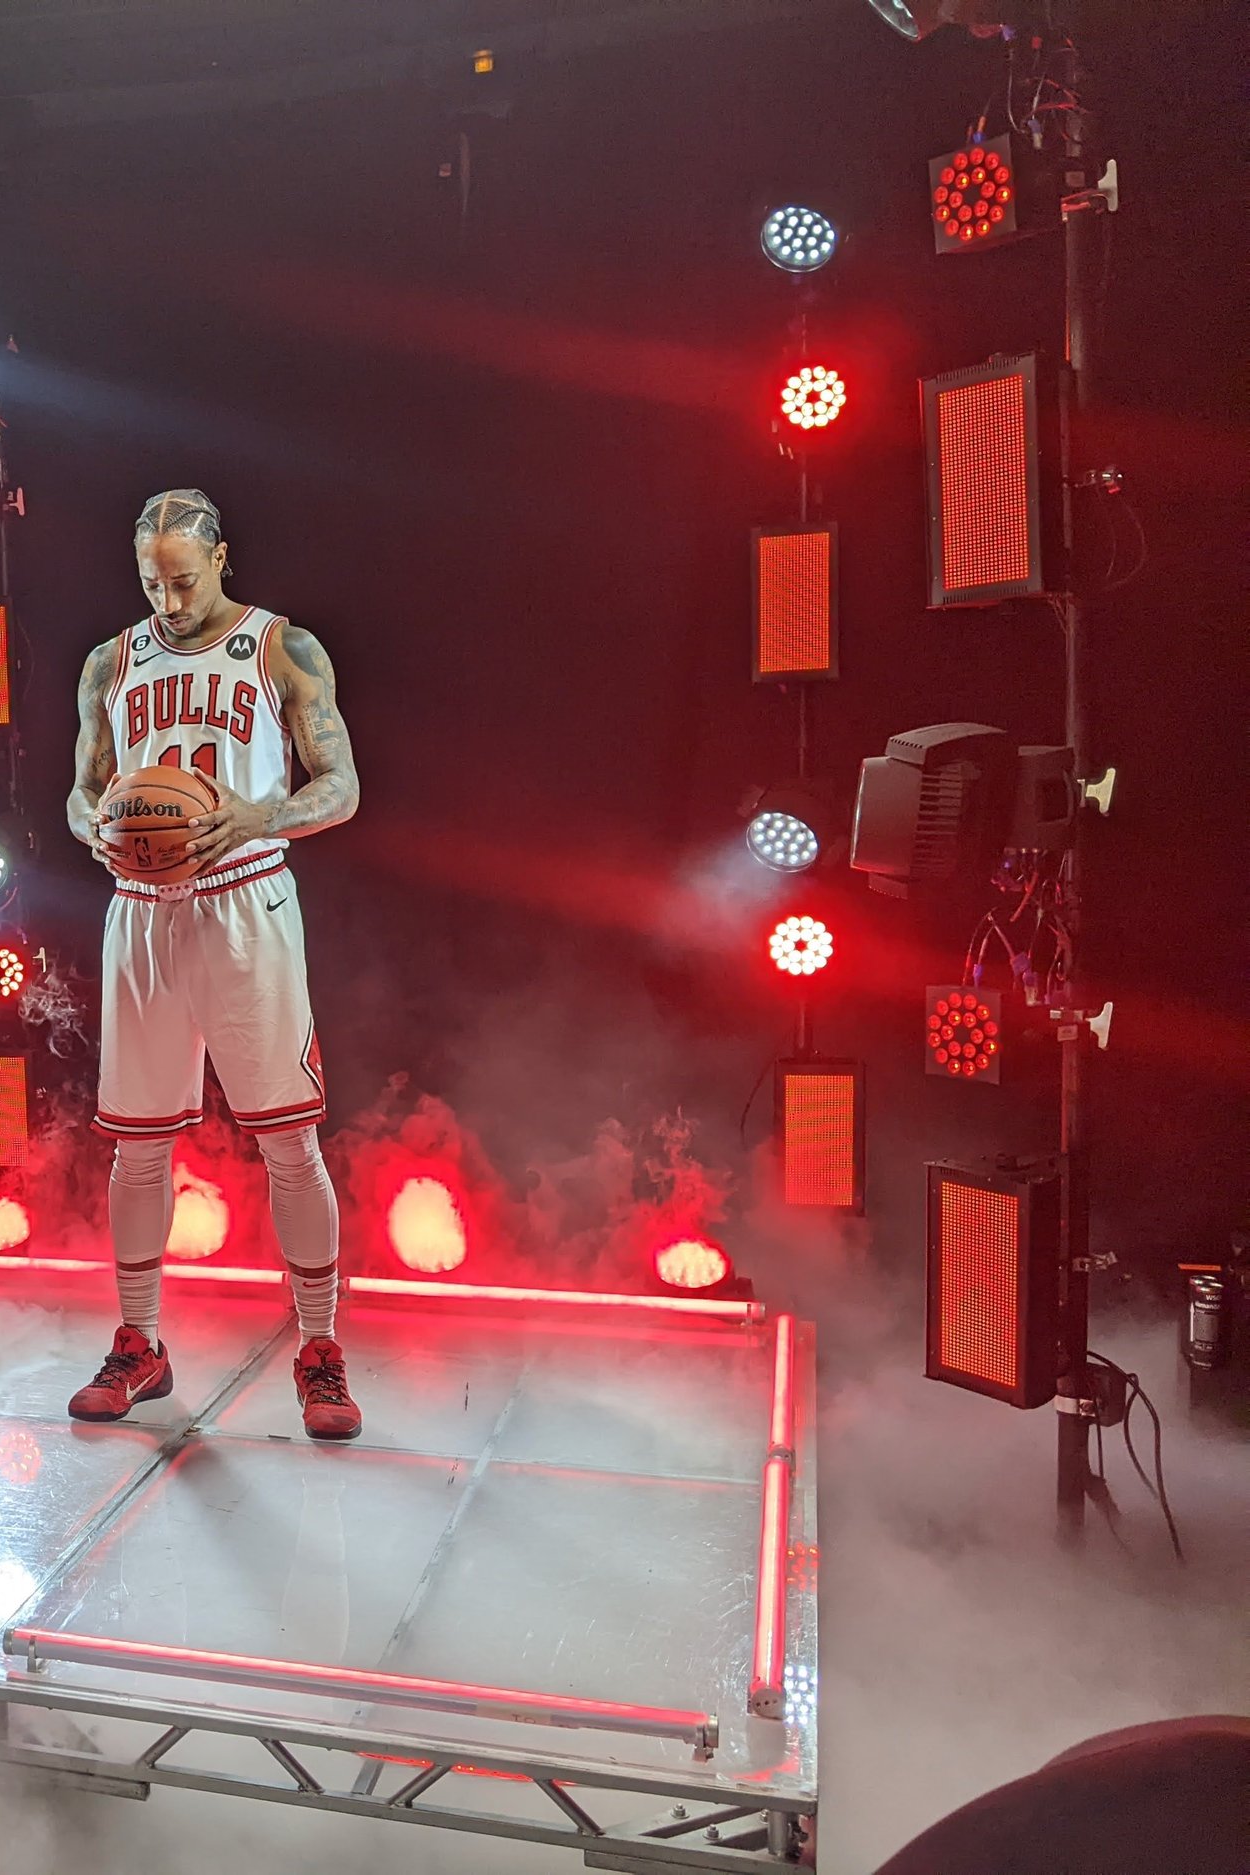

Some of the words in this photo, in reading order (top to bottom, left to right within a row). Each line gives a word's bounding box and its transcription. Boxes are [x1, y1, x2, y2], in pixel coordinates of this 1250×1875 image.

[136, 637, 147, 650] 6
[126, 673, 258, 750] BULLS
[107, 796, 183, 820] Wilson
